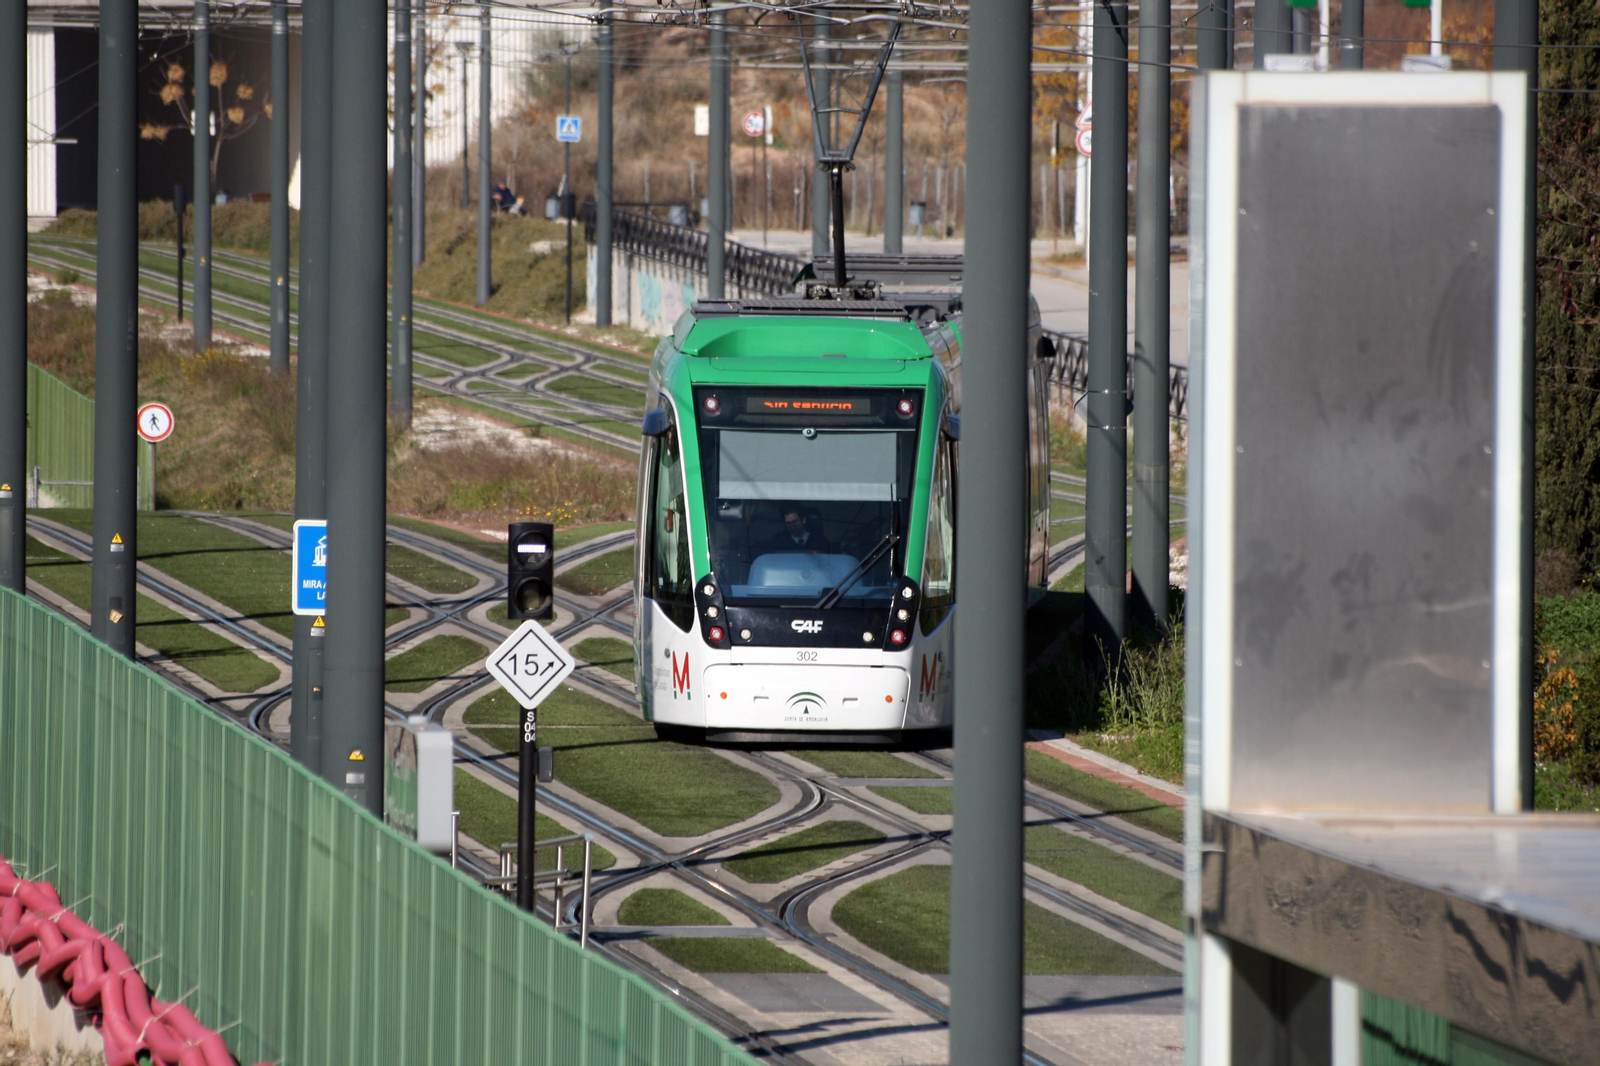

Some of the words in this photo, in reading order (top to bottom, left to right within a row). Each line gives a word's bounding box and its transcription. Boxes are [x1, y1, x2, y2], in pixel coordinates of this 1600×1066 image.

[302, 579, 322, 589] MIRA
[791, 619, 823, 633] CAF
[797, 651, 818, 662] 302
[508, 653, 539, 676] 15
[672, 650, 691, 699] M
[526, 711, 536, 722] S
[524, 722, 536, 732] 04
[524, 732, 536, 743] 04
